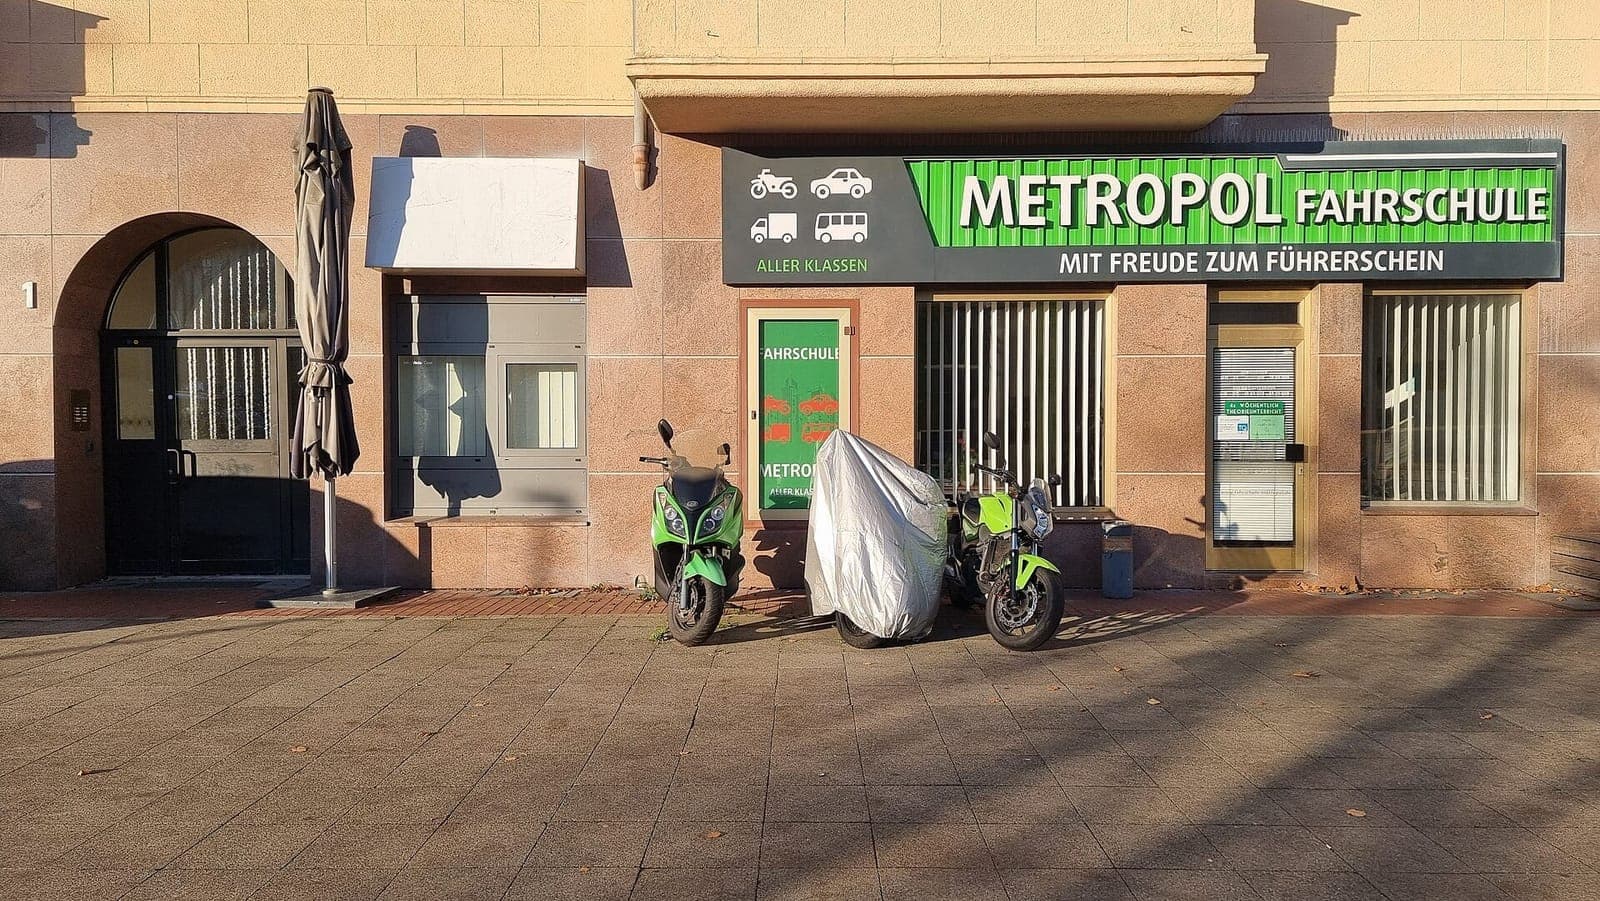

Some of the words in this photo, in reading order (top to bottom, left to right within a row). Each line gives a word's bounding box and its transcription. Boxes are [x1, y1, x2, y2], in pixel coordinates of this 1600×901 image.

[960, 172, 1282, 227] METROPOL
[1296, 187, 1547, 223] FAHRSCHULE
[757, 259, 800, 272] ALLER
[804, 258, 868, 272] KLASSEN
[1059, 251, 1102, 273] MIT
[1110, 251, 1198, 273] FREUDE
[1206, 250, 1259, 272] ZUM
[1266, 246, 1444, 272] FÜHRERSCHEIN
[22, 282, 35, 308] 1
[770, 487, 793, 496] ALLER
